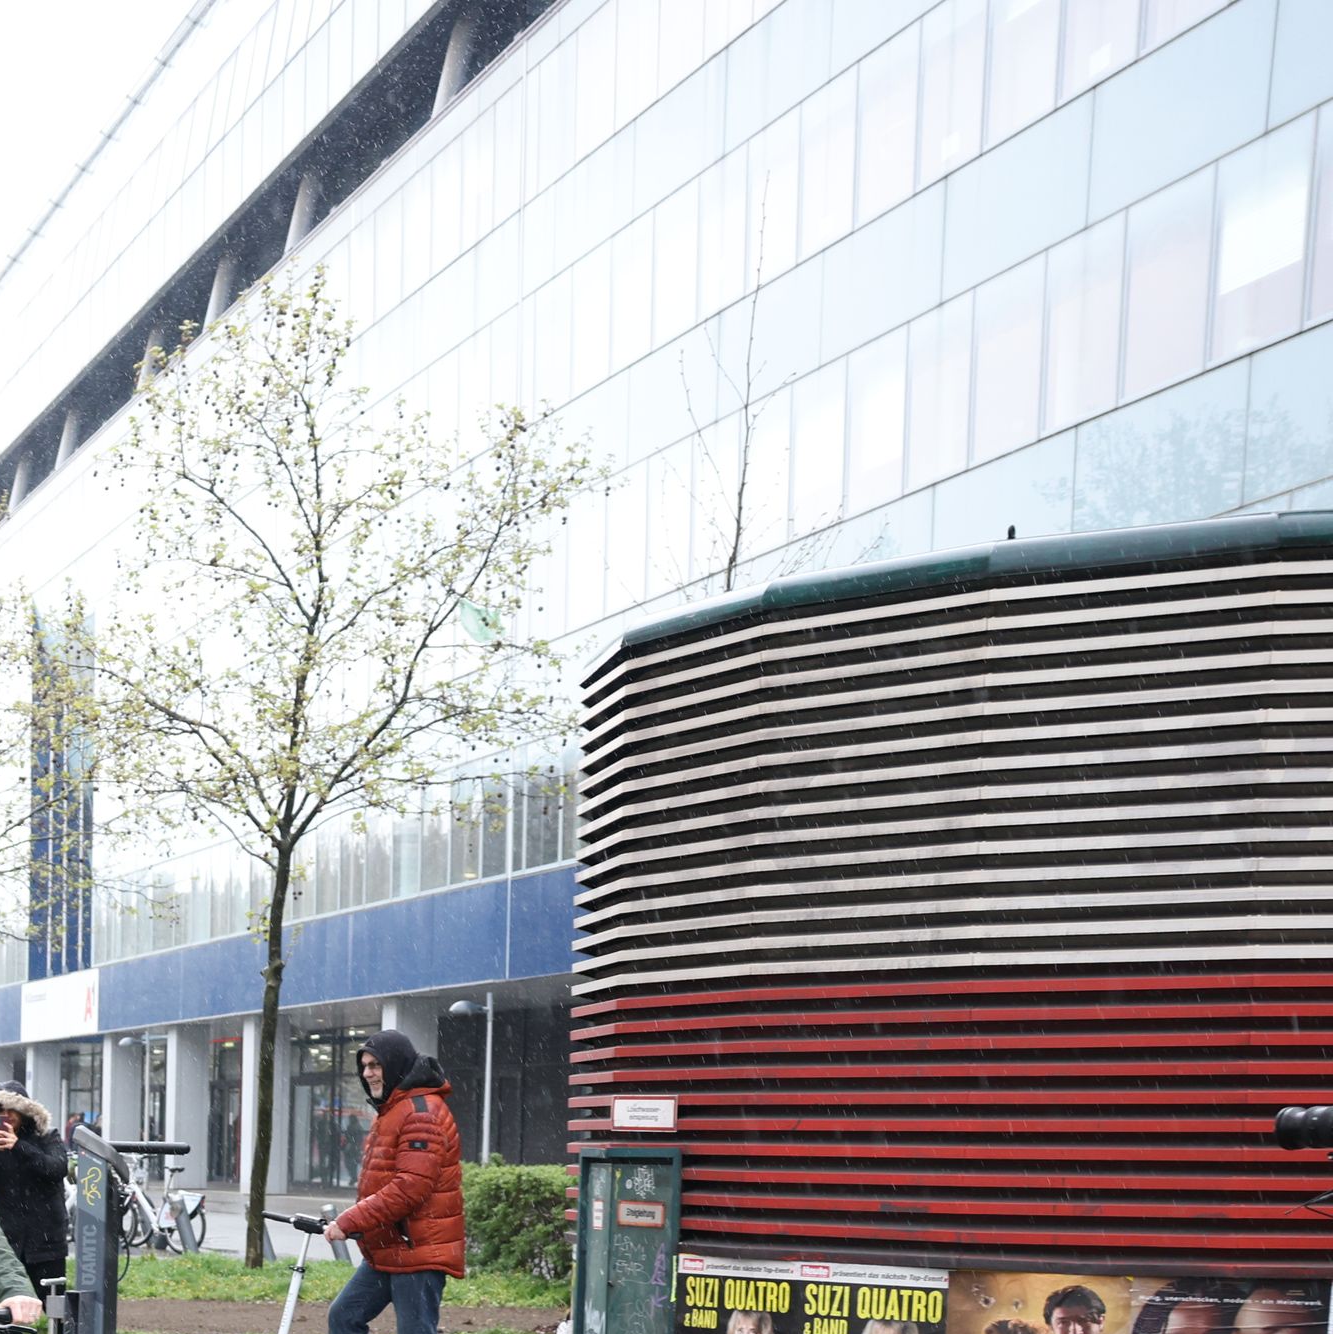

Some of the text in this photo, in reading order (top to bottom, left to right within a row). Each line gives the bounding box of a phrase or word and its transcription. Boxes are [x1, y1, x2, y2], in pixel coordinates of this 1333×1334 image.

[832, 1270, 867, 1278] präsentiert
[685, 1276, 791, 1313] SUZI QUATRO
[804, 1283, 943, 1324] SUZI QUATRO
[684, 1309, 718, 1329] & BAND
